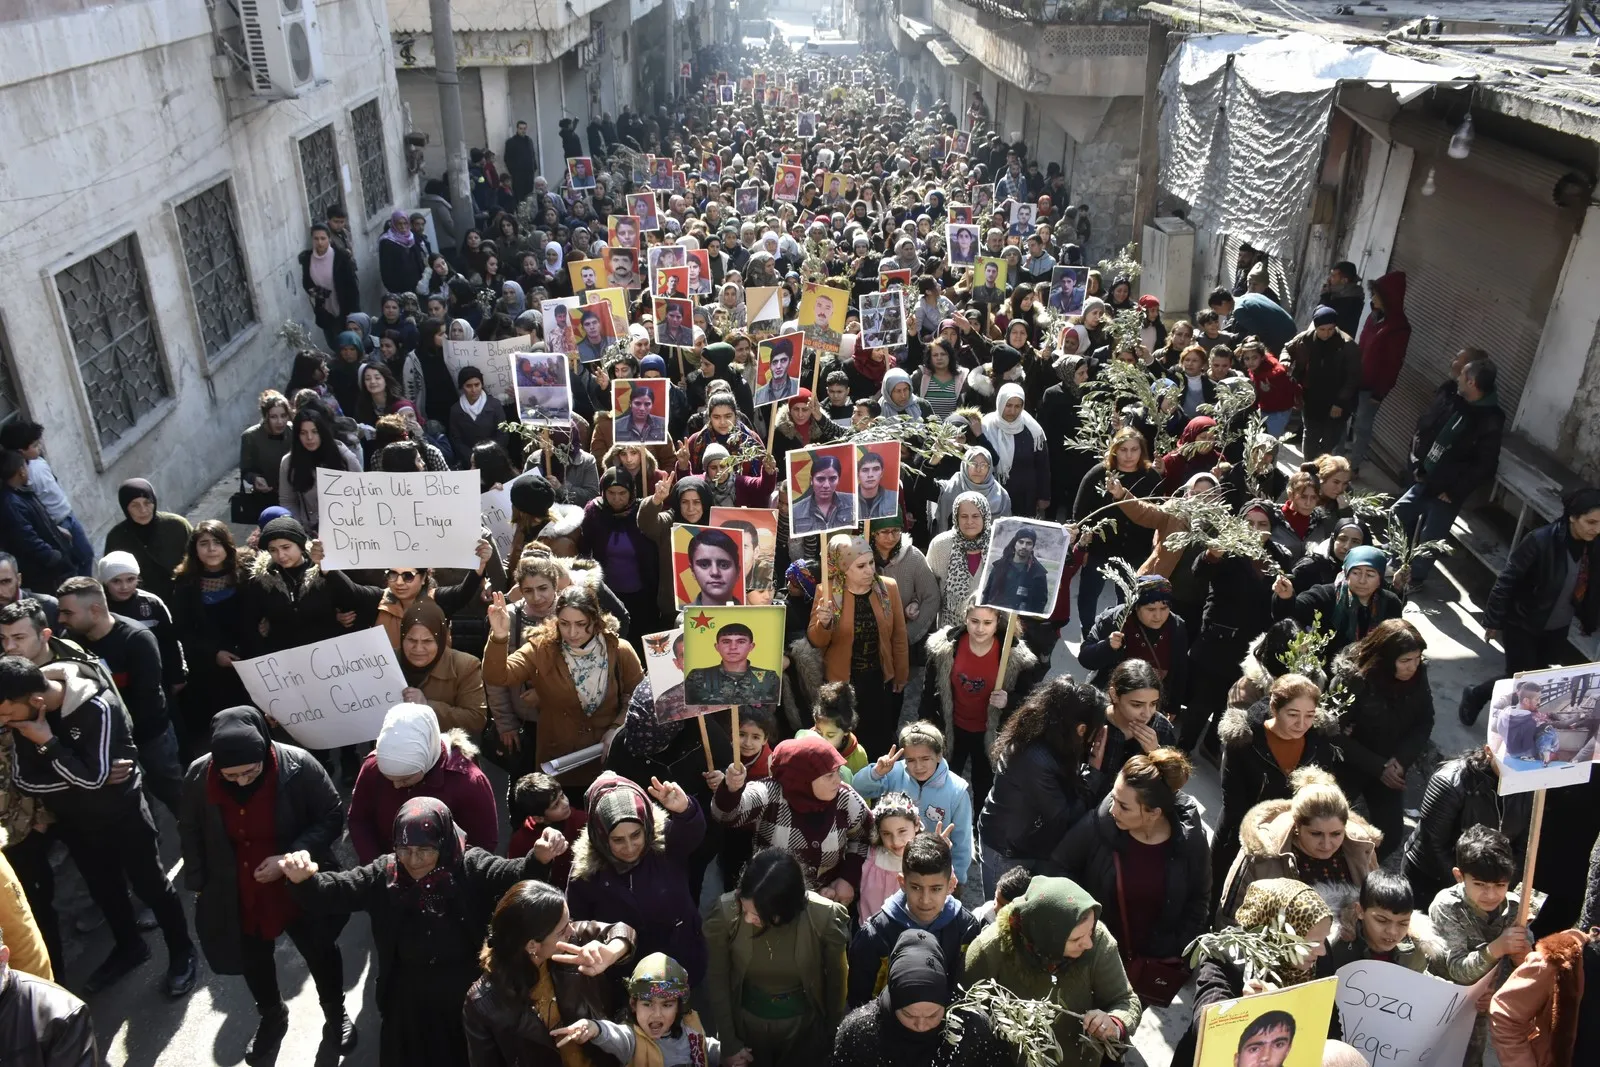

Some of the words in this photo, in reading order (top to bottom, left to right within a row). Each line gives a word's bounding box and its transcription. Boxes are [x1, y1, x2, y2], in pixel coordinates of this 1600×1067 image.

[453, 342, 470, 356] Em
[390, 476, 413, 496] Wê
[425, 475, 460, 496] Bibe
[328, 501, 364, 526] Gule
[377, 502, 396, 526] Di
[413, 501, 452, 538] Eniya
[333, 528, 380, 565] Dijmin
[255, 657, 305, 693] Efrin
[1344, 969, 1413, 1022] Soza
[1341, 1012, 1410, 1067] Veger
